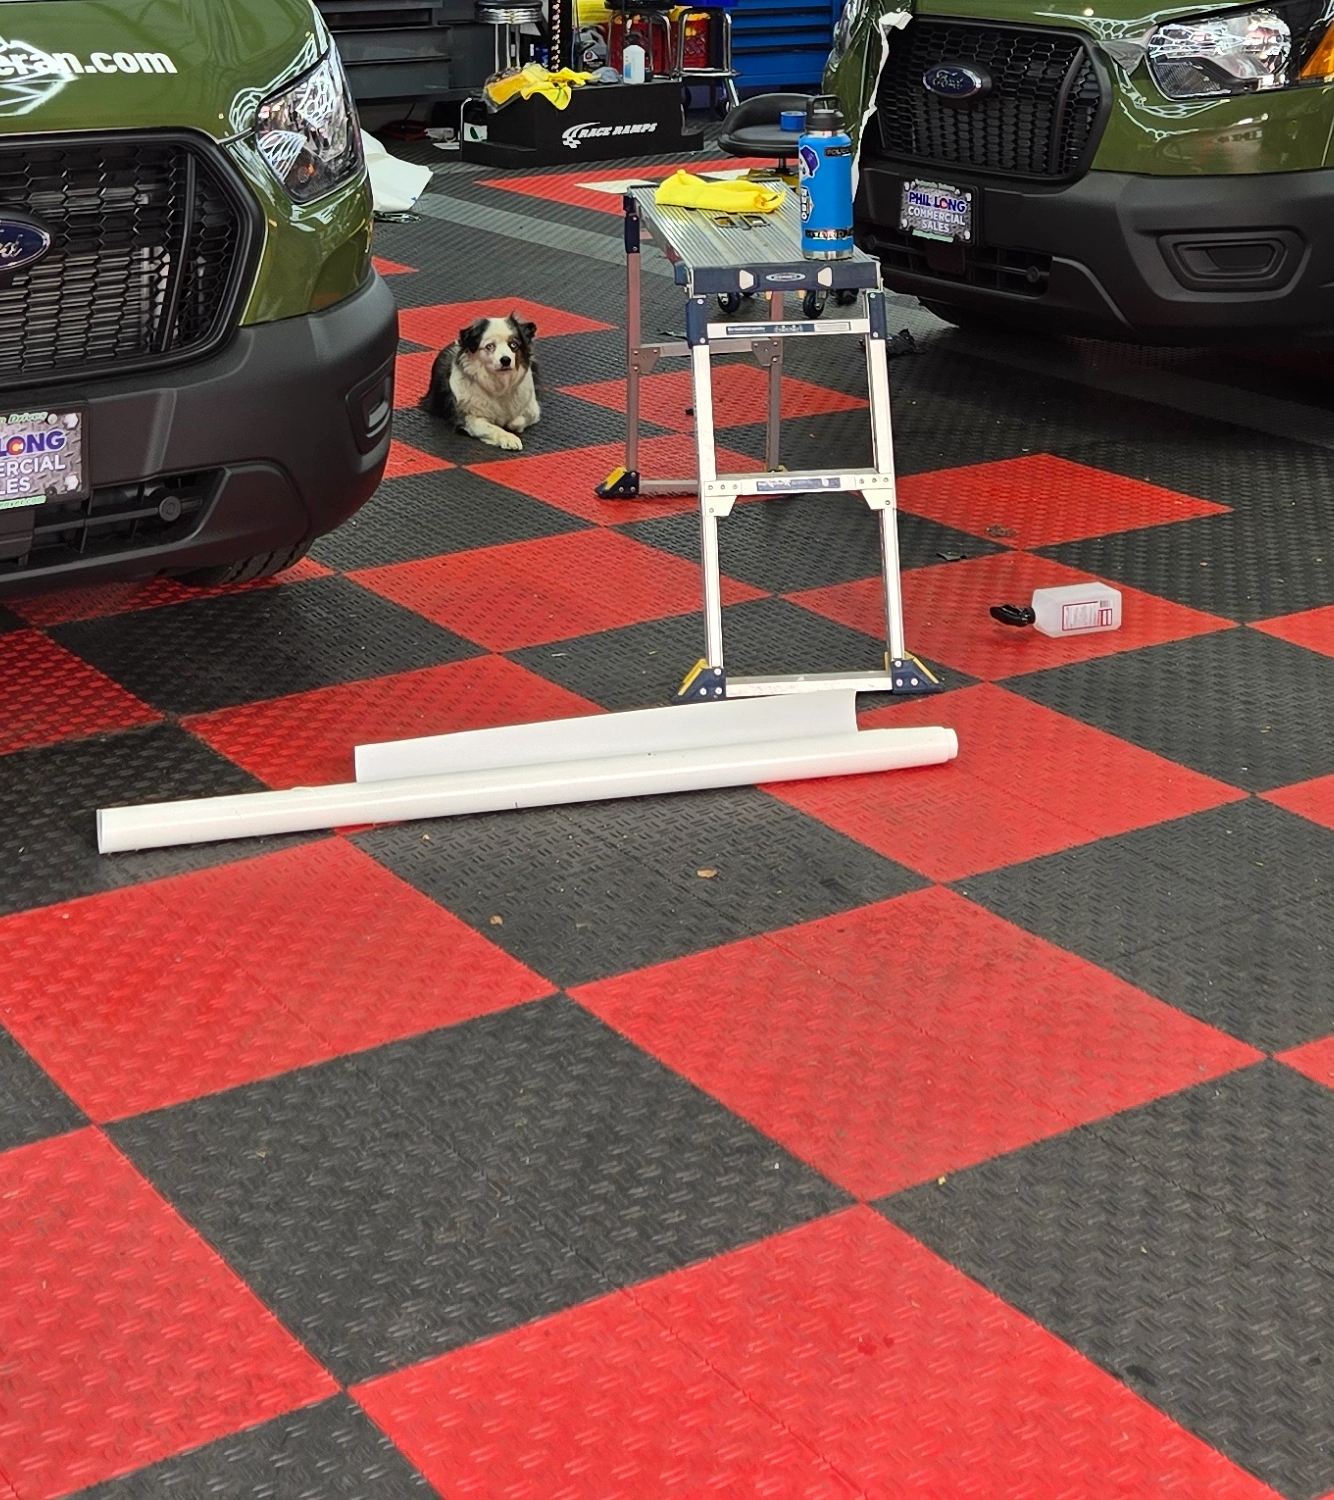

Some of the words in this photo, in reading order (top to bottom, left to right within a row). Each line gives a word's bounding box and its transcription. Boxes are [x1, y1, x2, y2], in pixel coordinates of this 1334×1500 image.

[578, 127, 613, 138] RACE
[612, 123, 658, 135] RAMPS
[909, 192, 931, 206] PHIL
[934, 197, 966, 212] LONG
[908, 206, 966, 226] COMMERCIAL
[922, 220, 950, 233] SALES
[8, 412, 48, 424] Drives
